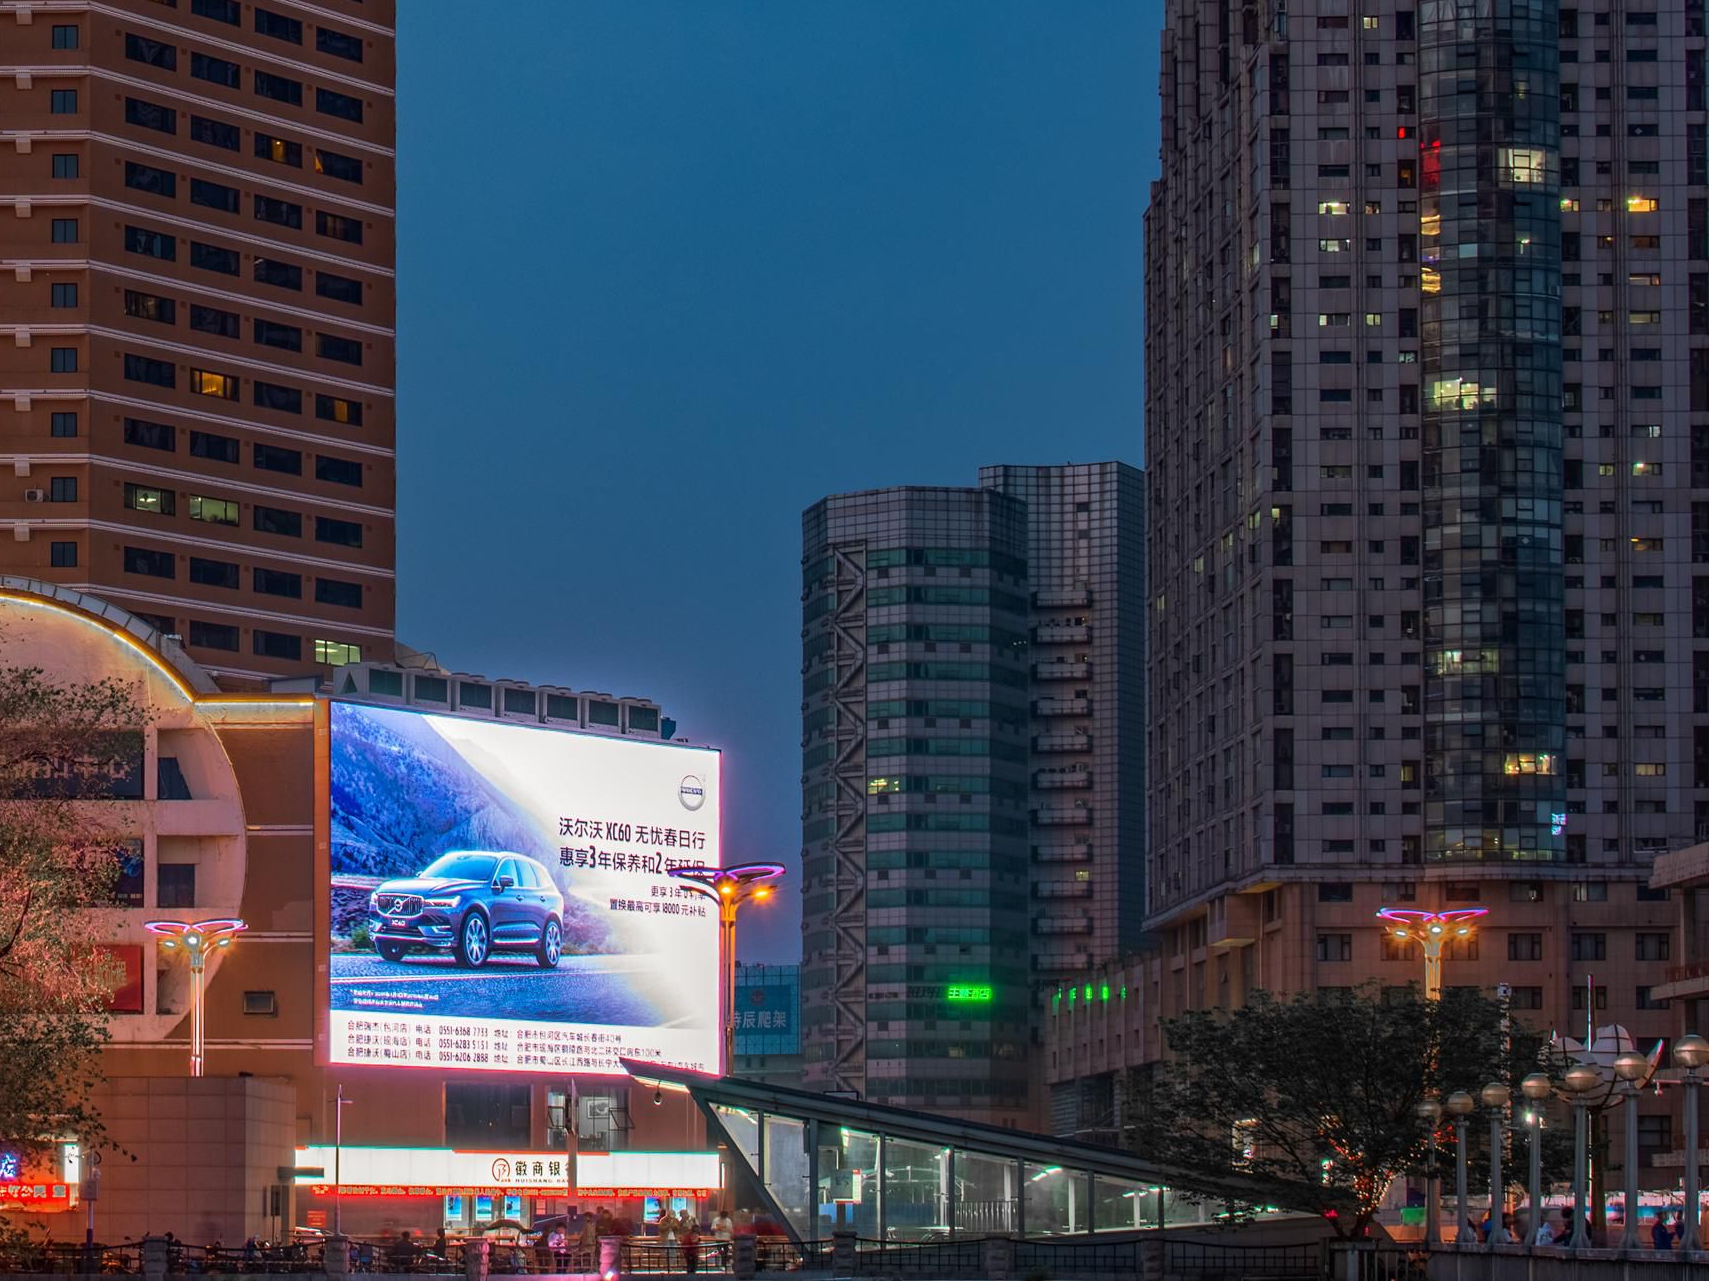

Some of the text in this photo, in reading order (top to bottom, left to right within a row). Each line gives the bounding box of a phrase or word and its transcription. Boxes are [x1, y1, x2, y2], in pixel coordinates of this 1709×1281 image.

[559, 816, 706, 850] 沃尔沃 XC60 无忧春日行
[515, 1160, 569, 1177] 徽商银
